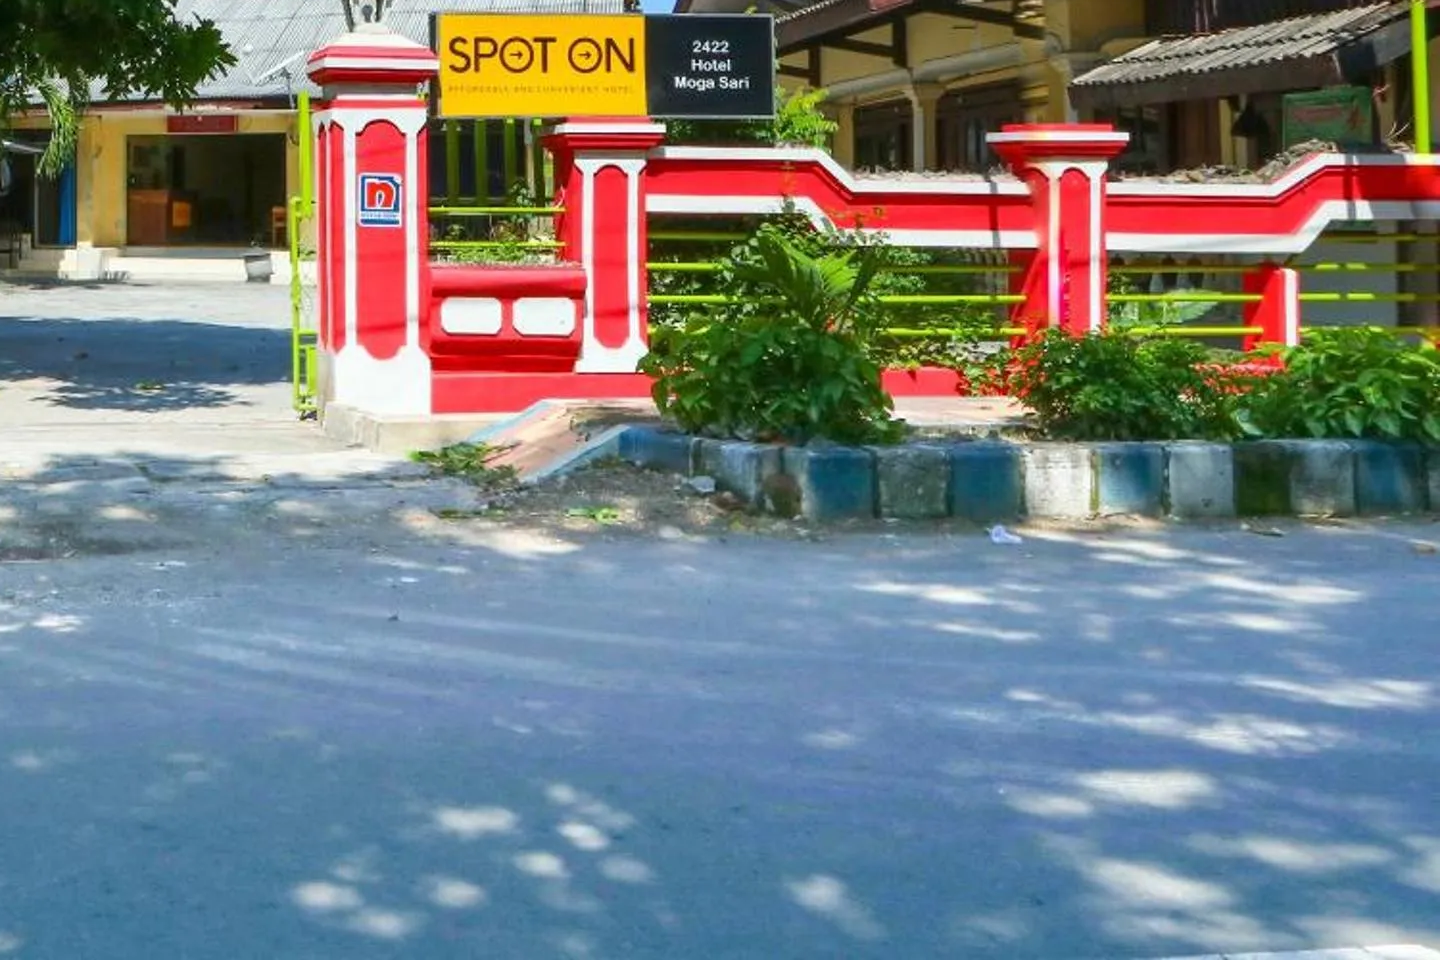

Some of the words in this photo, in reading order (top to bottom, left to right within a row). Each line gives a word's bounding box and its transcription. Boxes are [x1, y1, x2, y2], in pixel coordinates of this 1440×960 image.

[692, 40, 729, 53] 2422
[448, 37, 556, 73] SPOT
[567, 37, 635, 73] ON
[691, 59, 731, 72] Hotel
[674, 76, 715, 91] Moga
[719, 76, 750, 89] Sari
